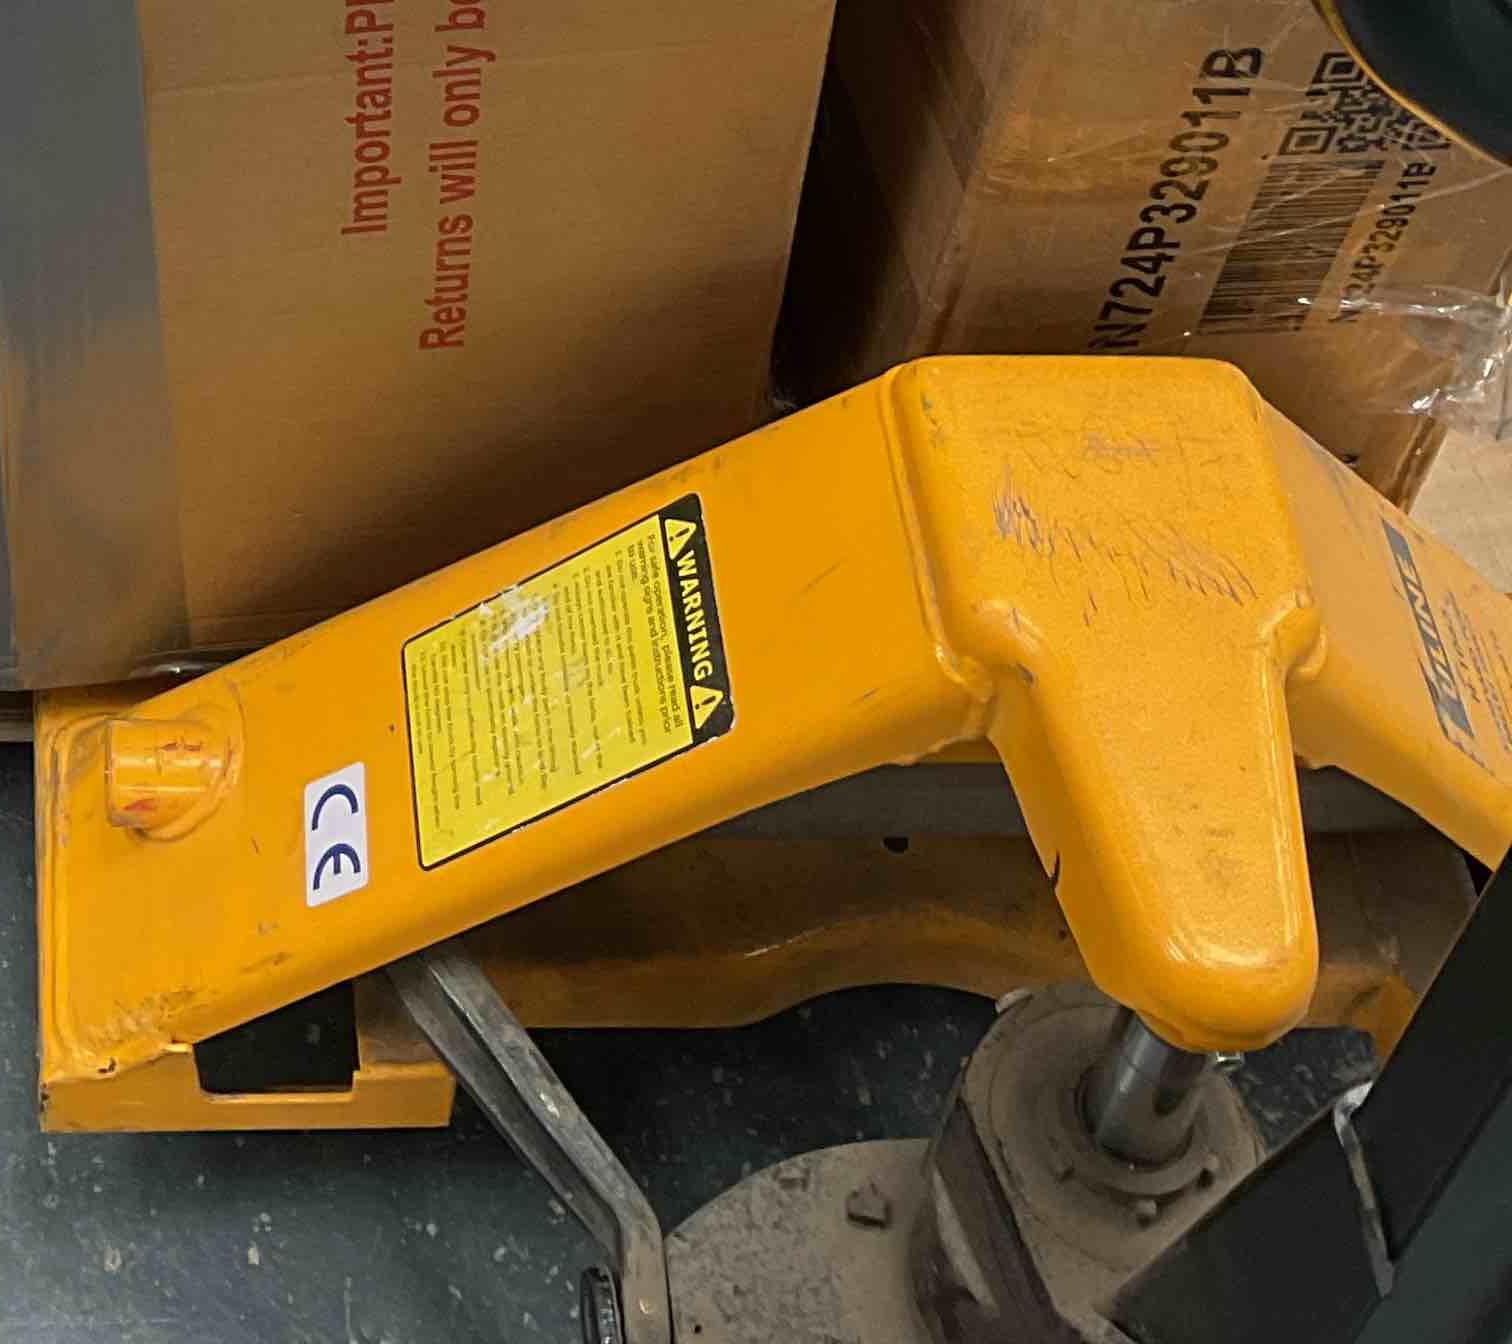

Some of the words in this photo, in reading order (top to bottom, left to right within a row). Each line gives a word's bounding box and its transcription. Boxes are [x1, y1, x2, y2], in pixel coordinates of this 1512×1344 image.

[432, 42, 497, 128] only
[428, 138, 479, 205] will
[1088, 47, 1264, 349] N724P329011B
[418, 212, 474, 350] Returns
[678, 550, 714, 681] WARNING
